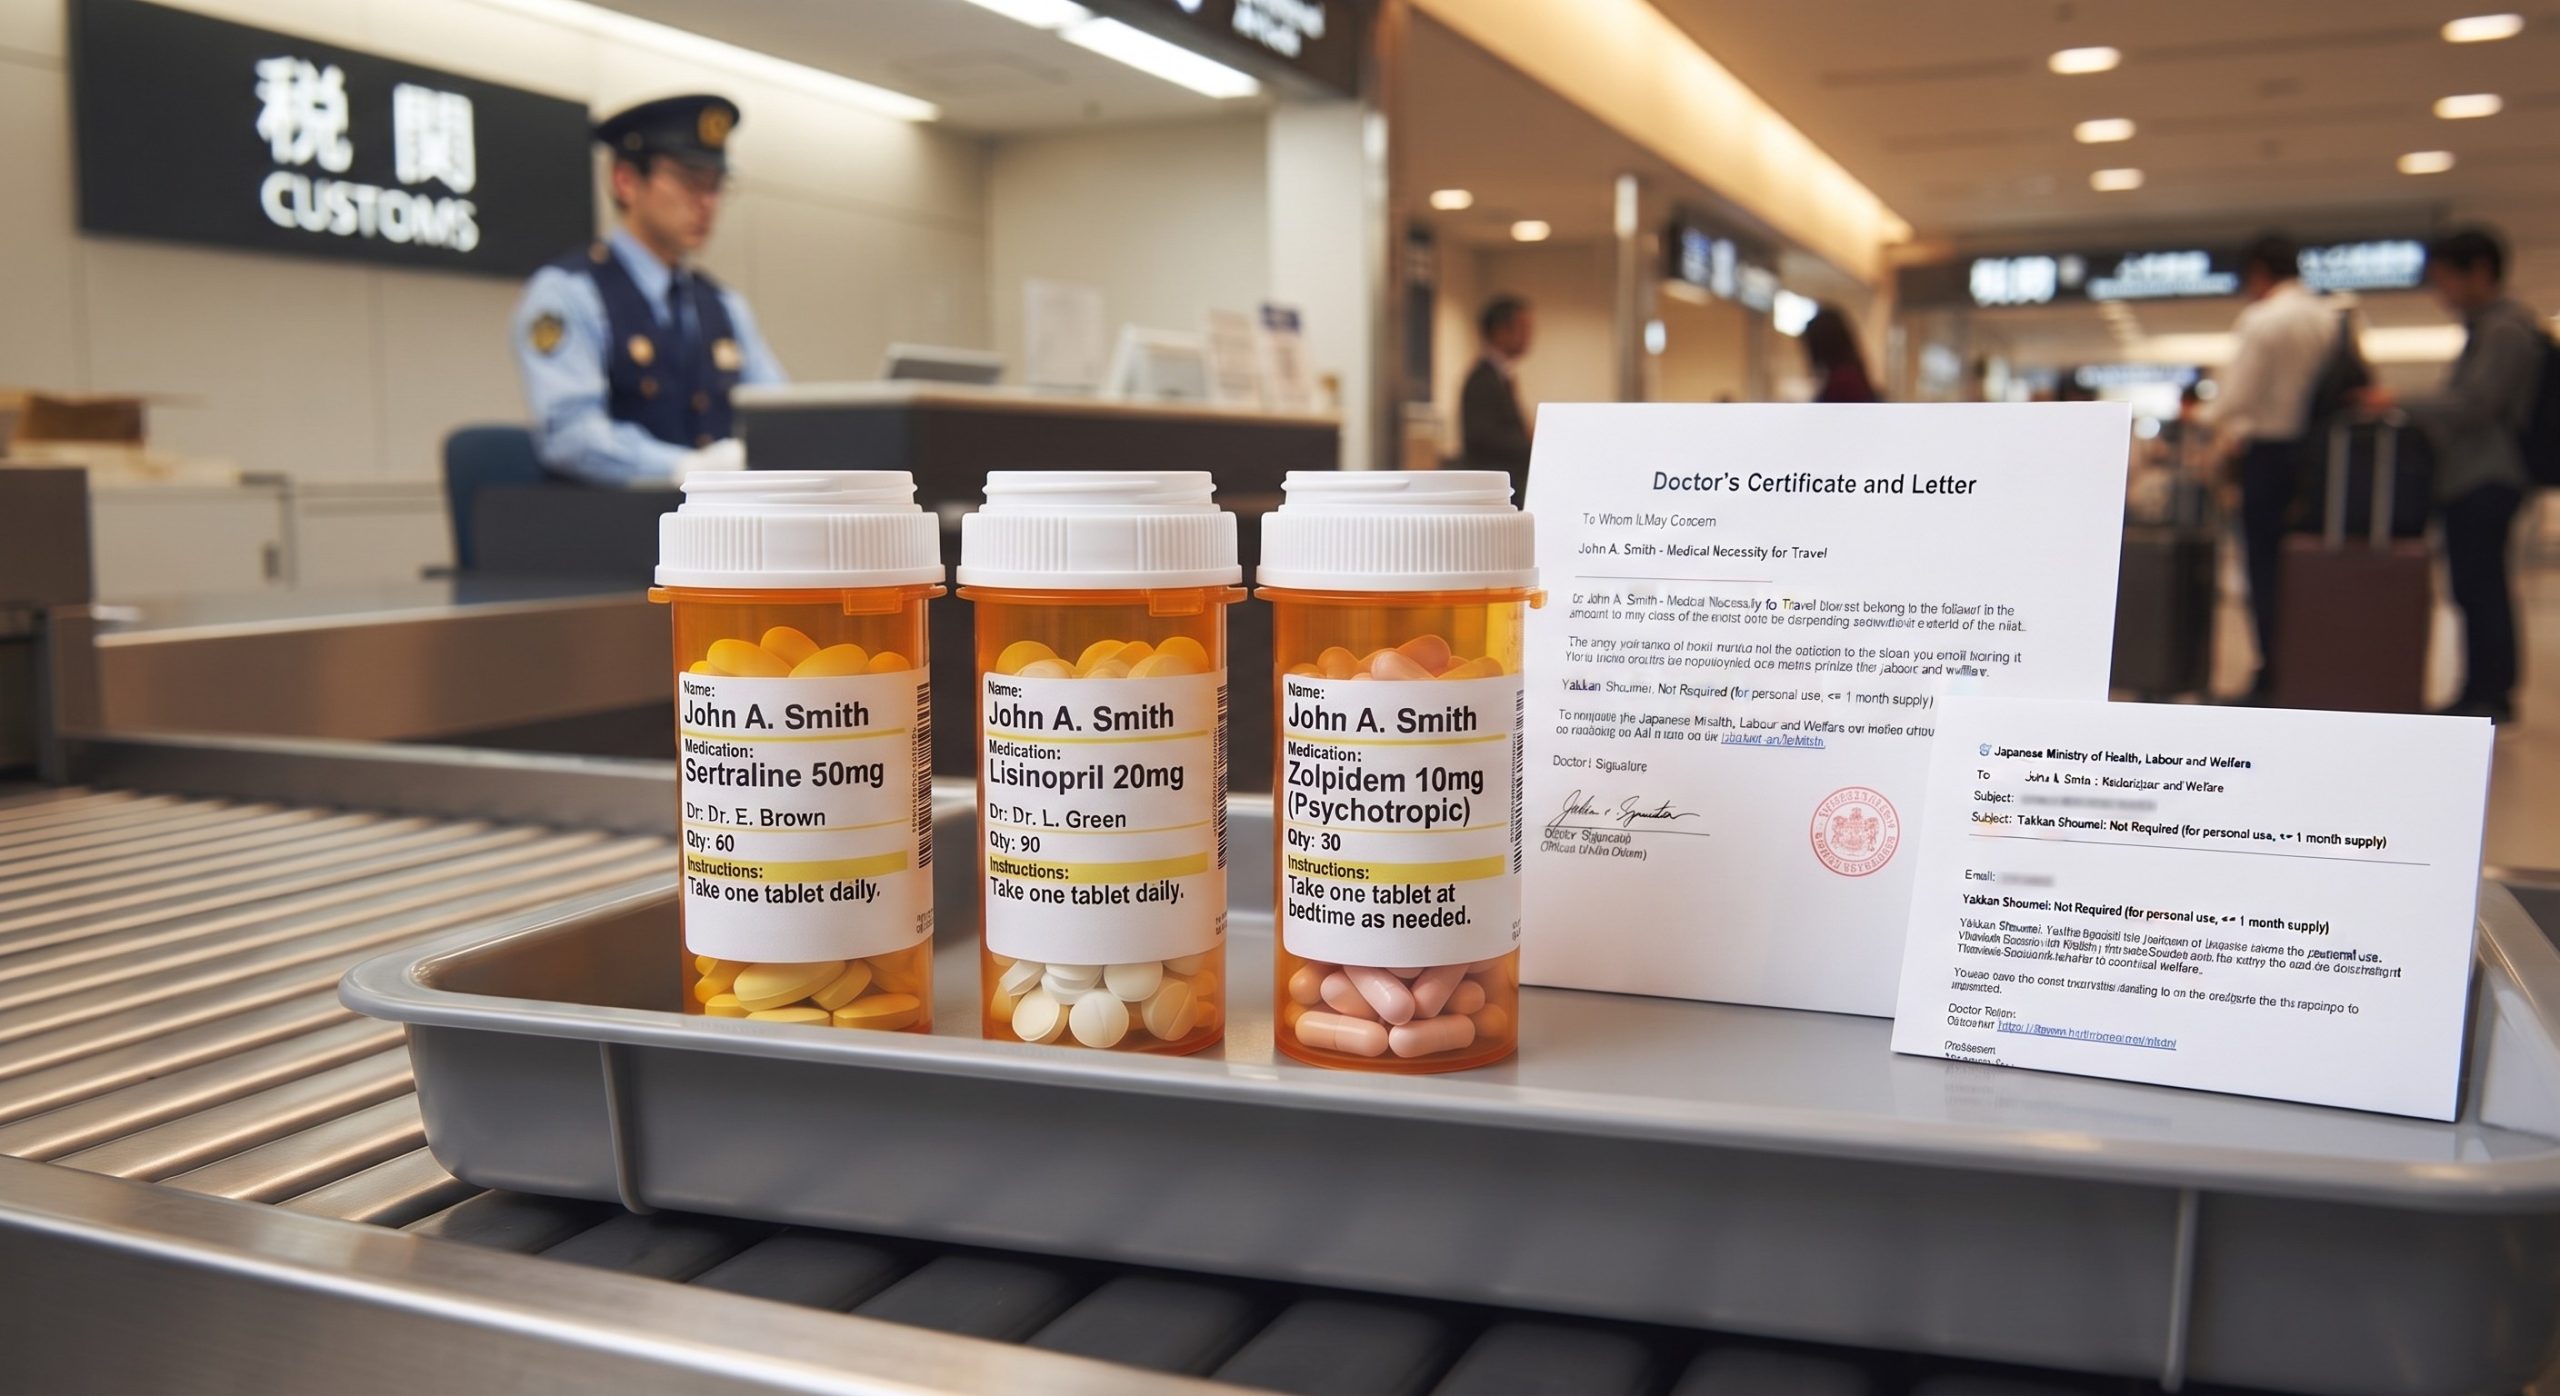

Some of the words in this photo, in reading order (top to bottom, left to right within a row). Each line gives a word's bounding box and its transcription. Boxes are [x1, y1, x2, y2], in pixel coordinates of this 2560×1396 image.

[261, 170, 479, 252] CUSTOMS
[1653, 471, 1740, 491] Doctor's
[1748, 473, 1857, 493] Certificate
[1864, 474, 1904, 494] and
[1912, 474, 1977, 494] Letter
[1584, 513, 1595, 525] To
[1600, 514, 1633, 526] Whom
[1579, 543, 1606, 554] John
[1609, 544, 1619, 555] A.
[1624, 544, 1656, 555] Smith
[1667, 545, 1709, 556] Medical
[1713, 545, 1768, 561] Necessity
[1772, 546, 1788, 558] for
[1792, 547, 1827, 558] Travel
[1627, 594, 1657, 606] Smith
[1921, 603, 1937, 614] the
[1984, 604, 1994, 615] in
[1998, 604, 2014, 616] the
[1678, 611, 1689, 621] of
[1693, 612, 1708, 622] the
[1772, 613, 1784, 624] be
[1962, 619, 1975, 630] of
[1978, 620, 1995, 630] the
[1569, 636, 1587, 647] The
[1776, 644, 1792, 655] the
[1845, 648, 1855, 657] to
[1859, 648, 1876, 658] the
[1914, 651, 1933, 661] you
[1922, 665, 1942, 675] and
[684, 681, 715, 697] Name:
[988, 681, 1022, 697] Name:
[1288, 682, 1325, 699] Name:
[1752, 689, 1797, 700] personal
[1847, 691, 1851, 702] 1
[1856, 693, 1889, 704] month
[1893, 695, 1933, 709] supply)
[685, 700, 736, 729] John
[745, 704, 773, 729] A.
[785, 702, 869, 729] Smith
[989, 702, 1043, 730] John
[1053, 705, 1082, 731] A.
[1093, 703, 1174, 732] Smith
[1289, 703, 1347, 732] John
[1356, 708, 1385, 733] A.
[1397, 706, 1477, 733] Smith
[1639, 713, 1690, 726] Japanese
[1781, 720, 1801, 730] and
[685, 739, 753, 758] Medication:
[989, 740, 1060, 759] Medication:
[1288, 742, 1361, 762] Medication:
[1994, 746, 2043, 759] Japanese
[2047, 749, 2088, 763] Ministry
[2091, 751, 2102, 762] of
[2105, 752, 2142, 764] Health,
[2146, 754, 2183, 765] Labour
[2186, 756, 2206, 767] and
[685, 758, 801, 787] Sertraline
[812, 762, 884, 788] 50mg
[990, 758, 1104, 795] Lisinopril
[1113, 764, 1184, 790] 20mg
[1288, 760, 1405, 795] Zolpidem
[1416, 767, 1484, 795] 10mg
[1978, 770, 1990, 780] To
[1974, 791, 2014, 803] Subject:
[687, 802, 703, 820] Dr:
[708, 805, 730, 824] Dr.
[736, 808, 753, 825] E.
[760, 809, 826, 826] Brown
[990, 803, 1007, 821] Dr:
[1013, 807, 1036, 825] Dr.
[1043, 810, 1060, 827] L.
[1066, 810, 1126, 828] Green
[1288, 790, 1471, 829] (Psychotropic)
[687, 830, 710, 852] Qty:
[716, 835, 734, 852] 60
[990, 831, 1015, 853] Qty:
[1021, 836, 1040, 853] 90
[1288, 829, 1315, 851] Qty:
[1321, 833, 1341, 850] 30
[2110, 821, 2128, 832] Not
[2132, 821, 2179, 837] Required
[2182, 825, 2200, 838] (for
[2203, 826, 2250, 839] personal
[2297, 832, 2301, 843] 1
[2306, 833, 2341, 845] month
[2345, 836, 2386, 849] supply)
[688, 856, 763, 878] Instructions:
[990, 856, 1068, 879] Instructions:
[1288, 855, 1369, 879] Instructions:
[688, 876, 719, 899] Take
[725, 888, 759, 902] one
[765, 884, 824, 903] tablet
[990, 877, 1024, 899] Take
[1030, 888, 1065, 903] one
[1071, 885, 1130, 904] tablet
[1136, 880, 1184, 904] daily.
[1289, 875, 1324, 899] Take
[1330, 887, 1365, 902] one
[1372, 885, 1431, 904] tablet
[1437, 884, 1456, 902] at
[1289, 898, 1355, 926] bedtime
[1361, 913, 1385, 928] as
[1393, 906, 1471, 928] needed.
[1963, 894, 2000, 906] Yakkan
[2002, 897, 2051, 910] Shoumei:
[2054, 902, 2072, 912] Not
[2075, 902, 2122, 917] Required
[2125, 905, 2144, 919] (for
[2146, 909, 2193, 922] personal
[2197, 913, 2218, 925] use,
[2240, 915, 2244, 926] 1
[2249, 918, 2285, 929] month
[2288, 919, 2329, 935] supply)
[2189, 989, 2205, 1000] the
[2259, 995, 2276, 1006] the
[1948, 1003, 1982, 1015] Doctor
